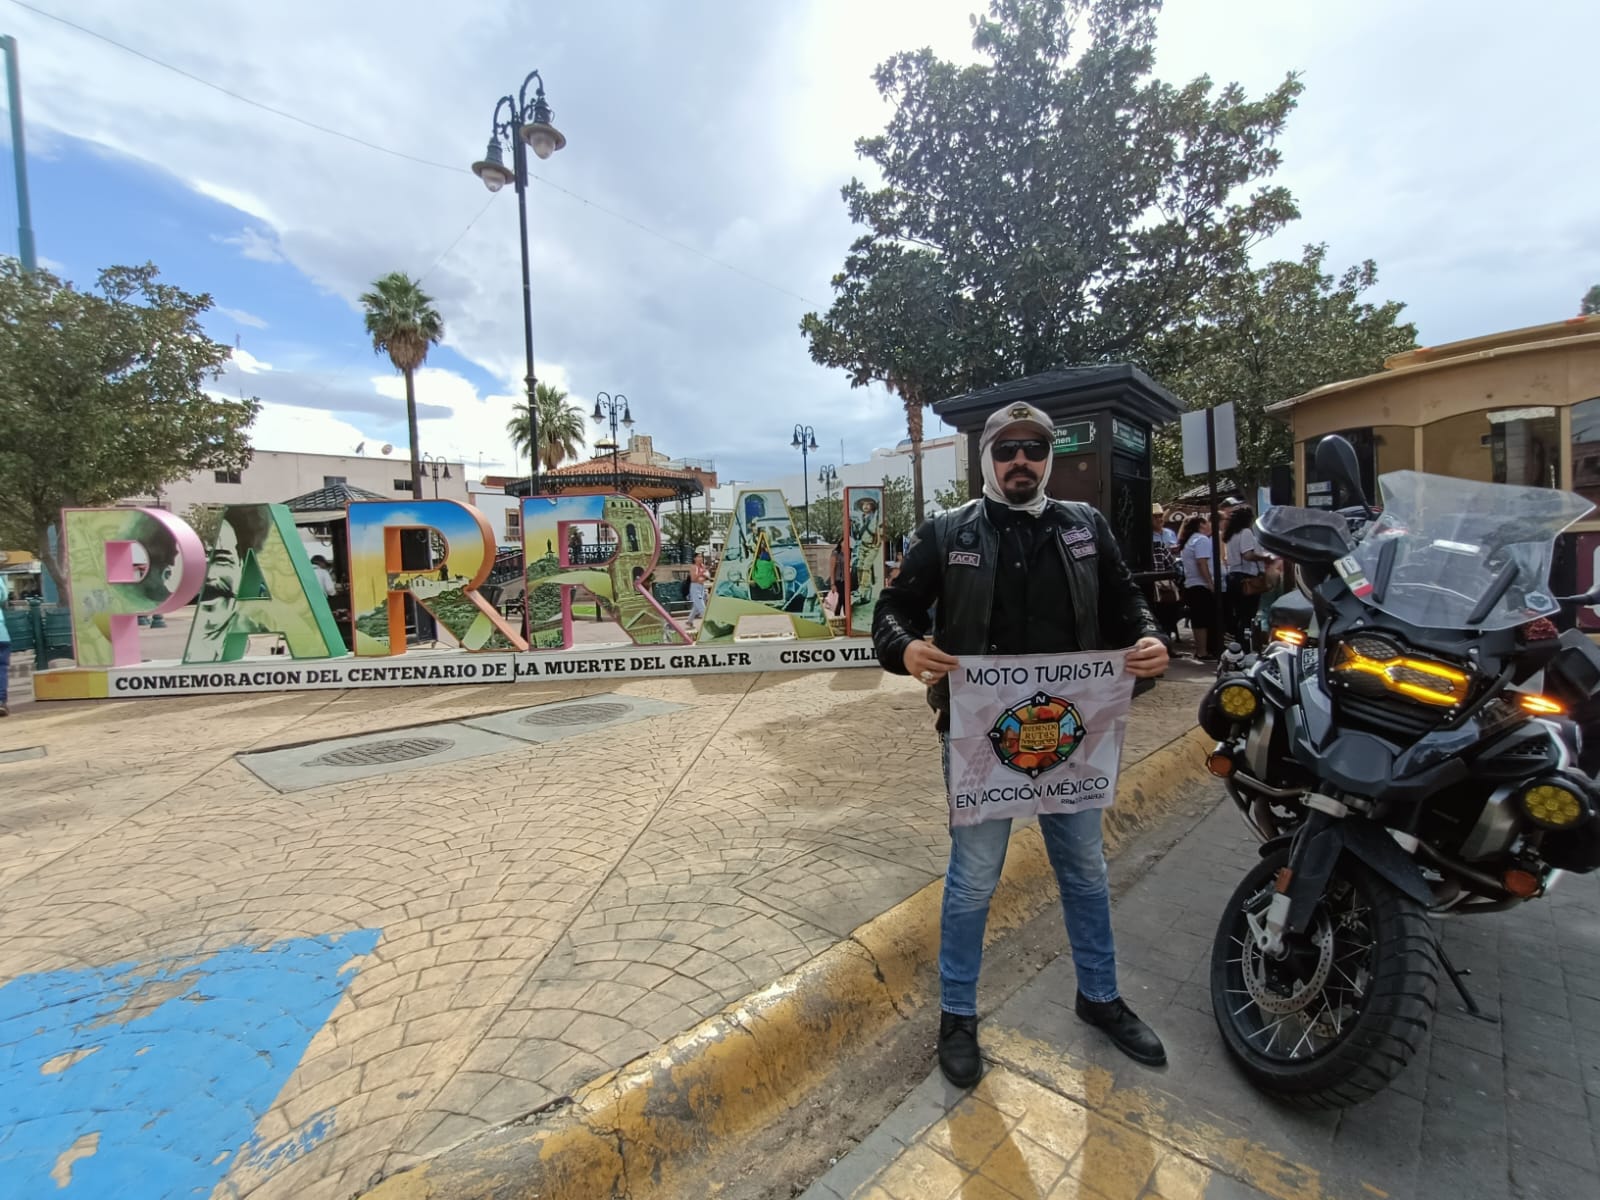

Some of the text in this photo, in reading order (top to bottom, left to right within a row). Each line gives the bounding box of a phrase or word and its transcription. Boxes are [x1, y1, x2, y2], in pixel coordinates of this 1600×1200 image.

[950, 553, 977, 564] ZACK
[115, 671, 302, 691] CONMEMORACION
[306, 669, 343, 684] DEL
[347, 663, 477, 682] CENTENARIO
[482, 663, 507, 676] DE
[515, 662, 540, 676] LA
[545, 658, 626, 675] MUERTE
[635, 656, 665, 670] DEL
[779, 649, 836, 664] CISCO
[839, 647, 878, 662] VILL
[966, 660, 1114, 686] MOTO TURISTA
[1035, 695, 1046, 704] N
[956, 793, 977, 808] EN
[981, 783, 1043, 803] ACCIÓN
[1046, 777, 1109, 797] MÉXICO
